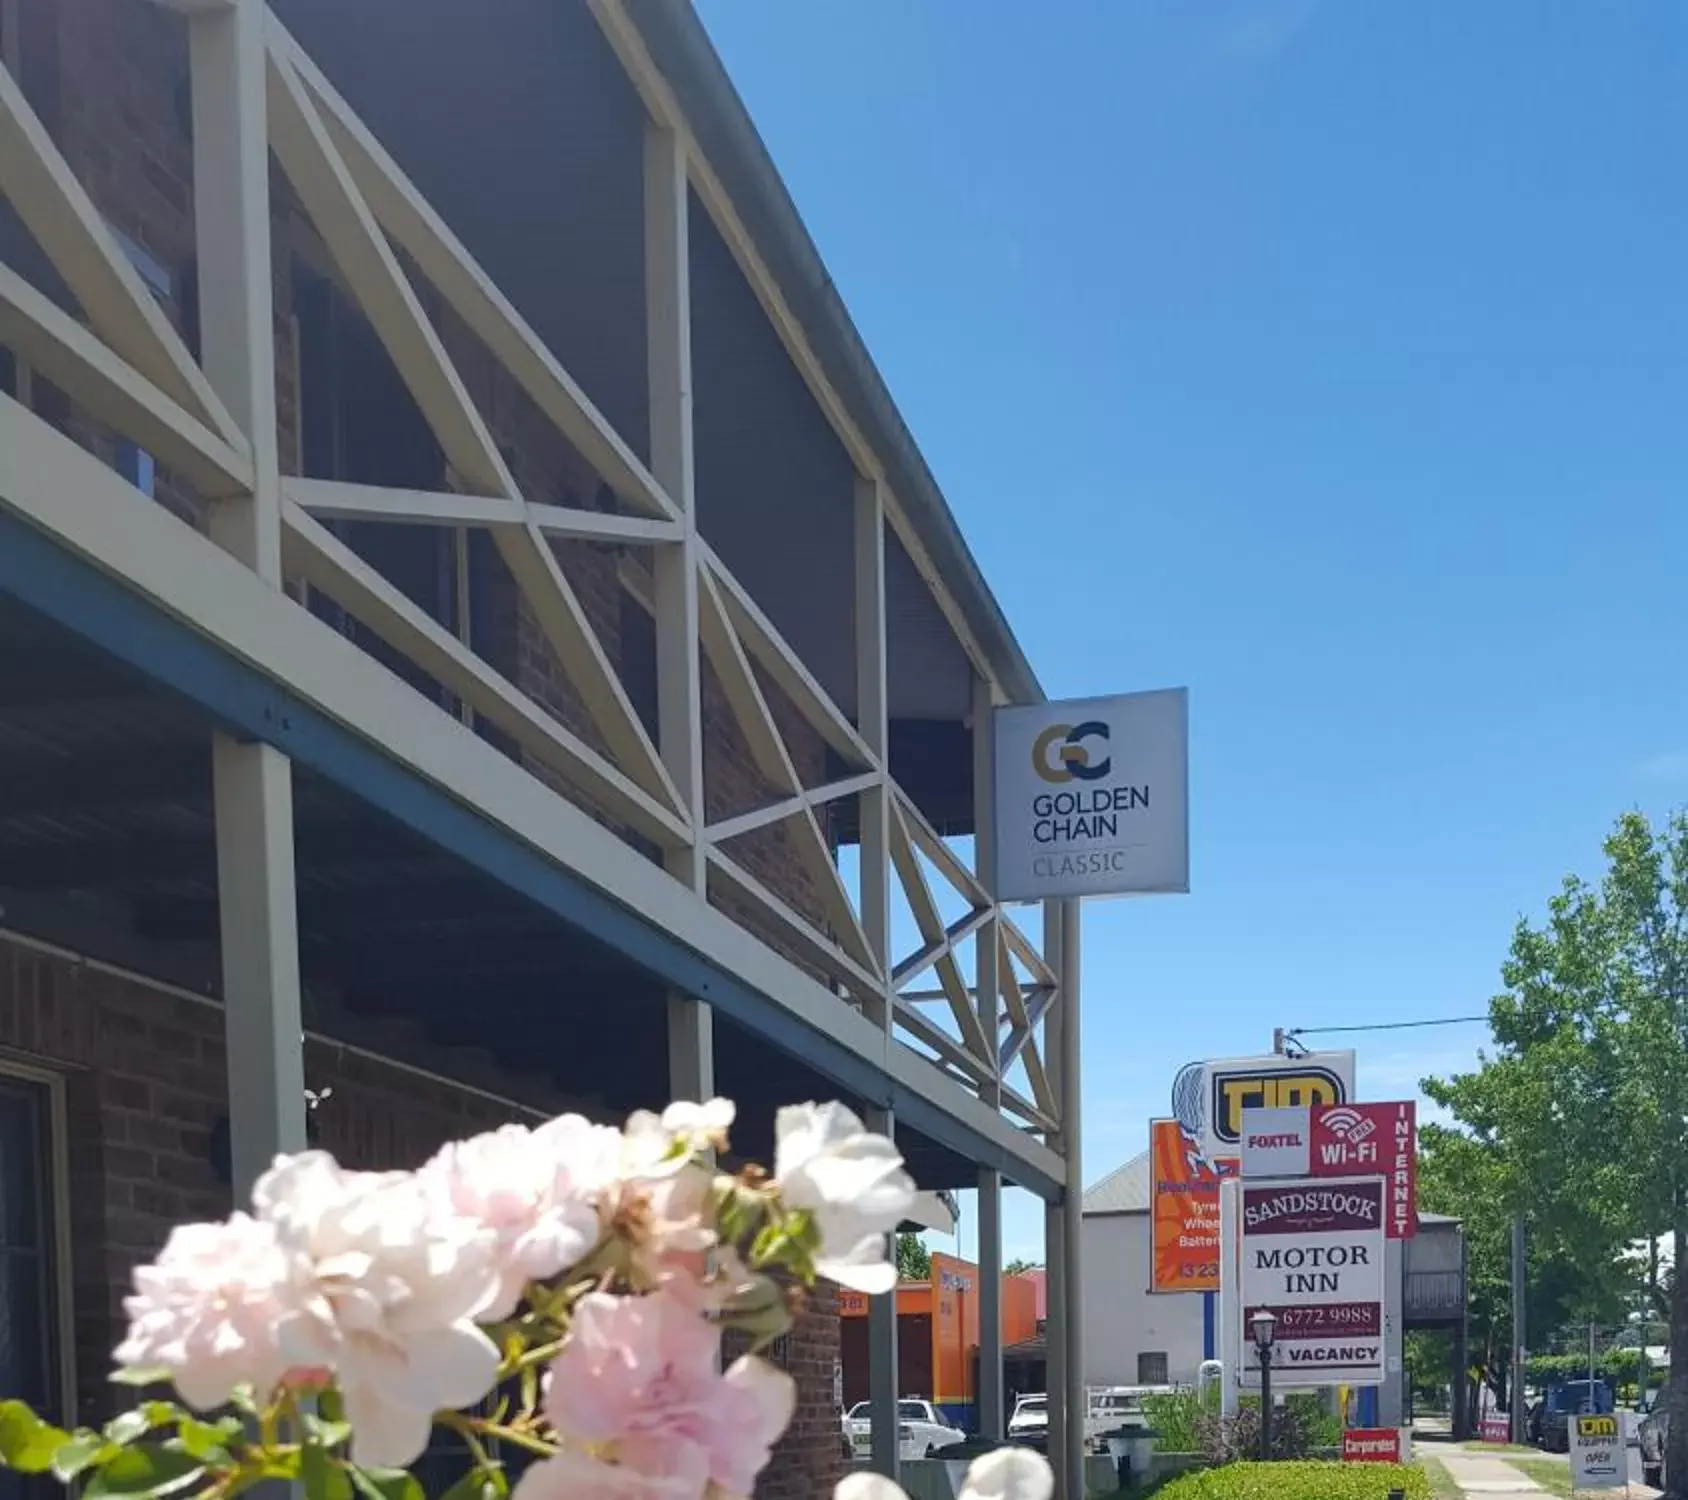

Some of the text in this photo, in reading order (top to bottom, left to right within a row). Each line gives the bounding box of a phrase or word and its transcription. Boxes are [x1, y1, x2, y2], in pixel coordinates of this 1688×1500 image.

[1033, 785, 1149, 818] GOLDEN
[1033, 813, 1117, 843] CHAIN
[1033, 851, 1125, 878] CLASSIC
[1248, 1134, 1303, 1149] FOXTEL
[1320, 1142, 1377, 1165] Wi-Fi
[1394, 1104, 1408, 1235] INTERNET
[1191, 1202, 1220, 1215] Tyre
[1245, 1192, 1377, 1226] SANDSTOCK
[1255, 1246, 1370, 1269] MOTOR
[1285, 1273, 1340, 1293] INN
[1283, 1307, 1373, 1325] 6772 9988
[1289, 1347, 1379, 1361] VACANCY
